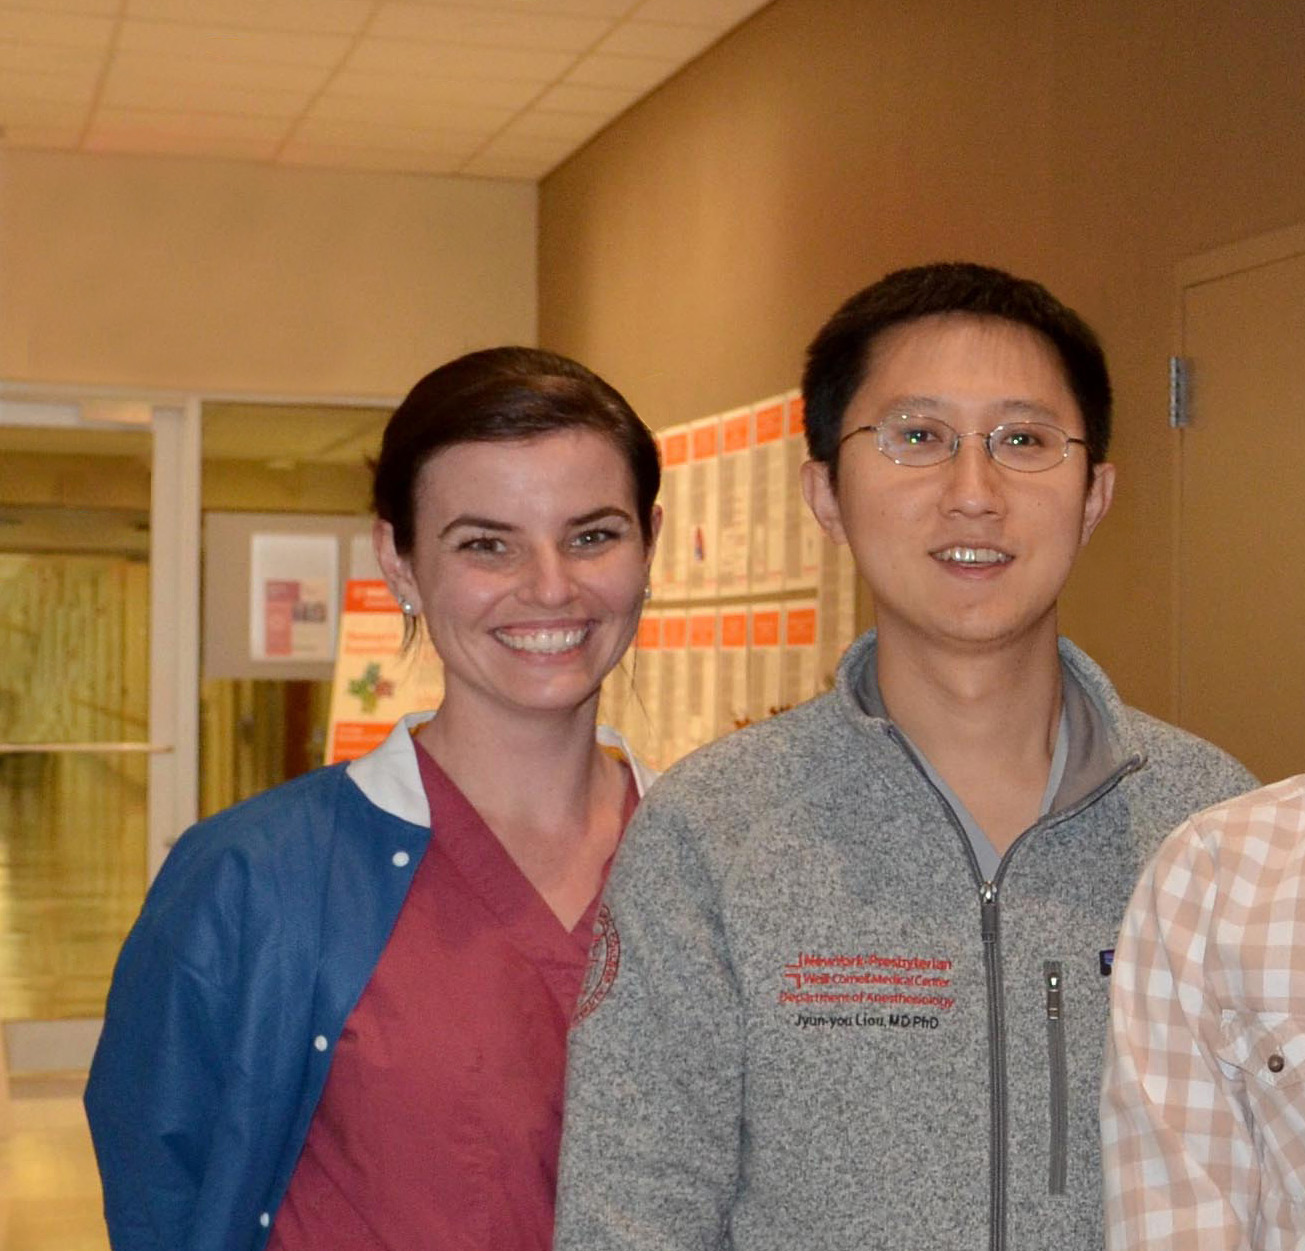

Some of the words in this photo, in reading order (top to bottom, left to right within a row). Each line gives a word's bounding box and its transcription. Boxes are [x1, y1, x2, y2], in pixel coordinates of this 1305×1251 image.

[803, 973, 830, 985] Weill
[832, 973, 870, 985] Cornell
[871, 974, 913, 985] Medical
[914, 975, 950, 987] Center
[779, 993, 850, 1004] Department
[852, 991, 864, 1002] of
[867, 992, 955, 1009] Anesthesiology
[795, 1014, 852, 1029] Jyun-you
[855, 1012, 887, 1027] Liou,
[889, 1014, 911, 1028] MD
[912, 1016, 939, 1029] PhD
